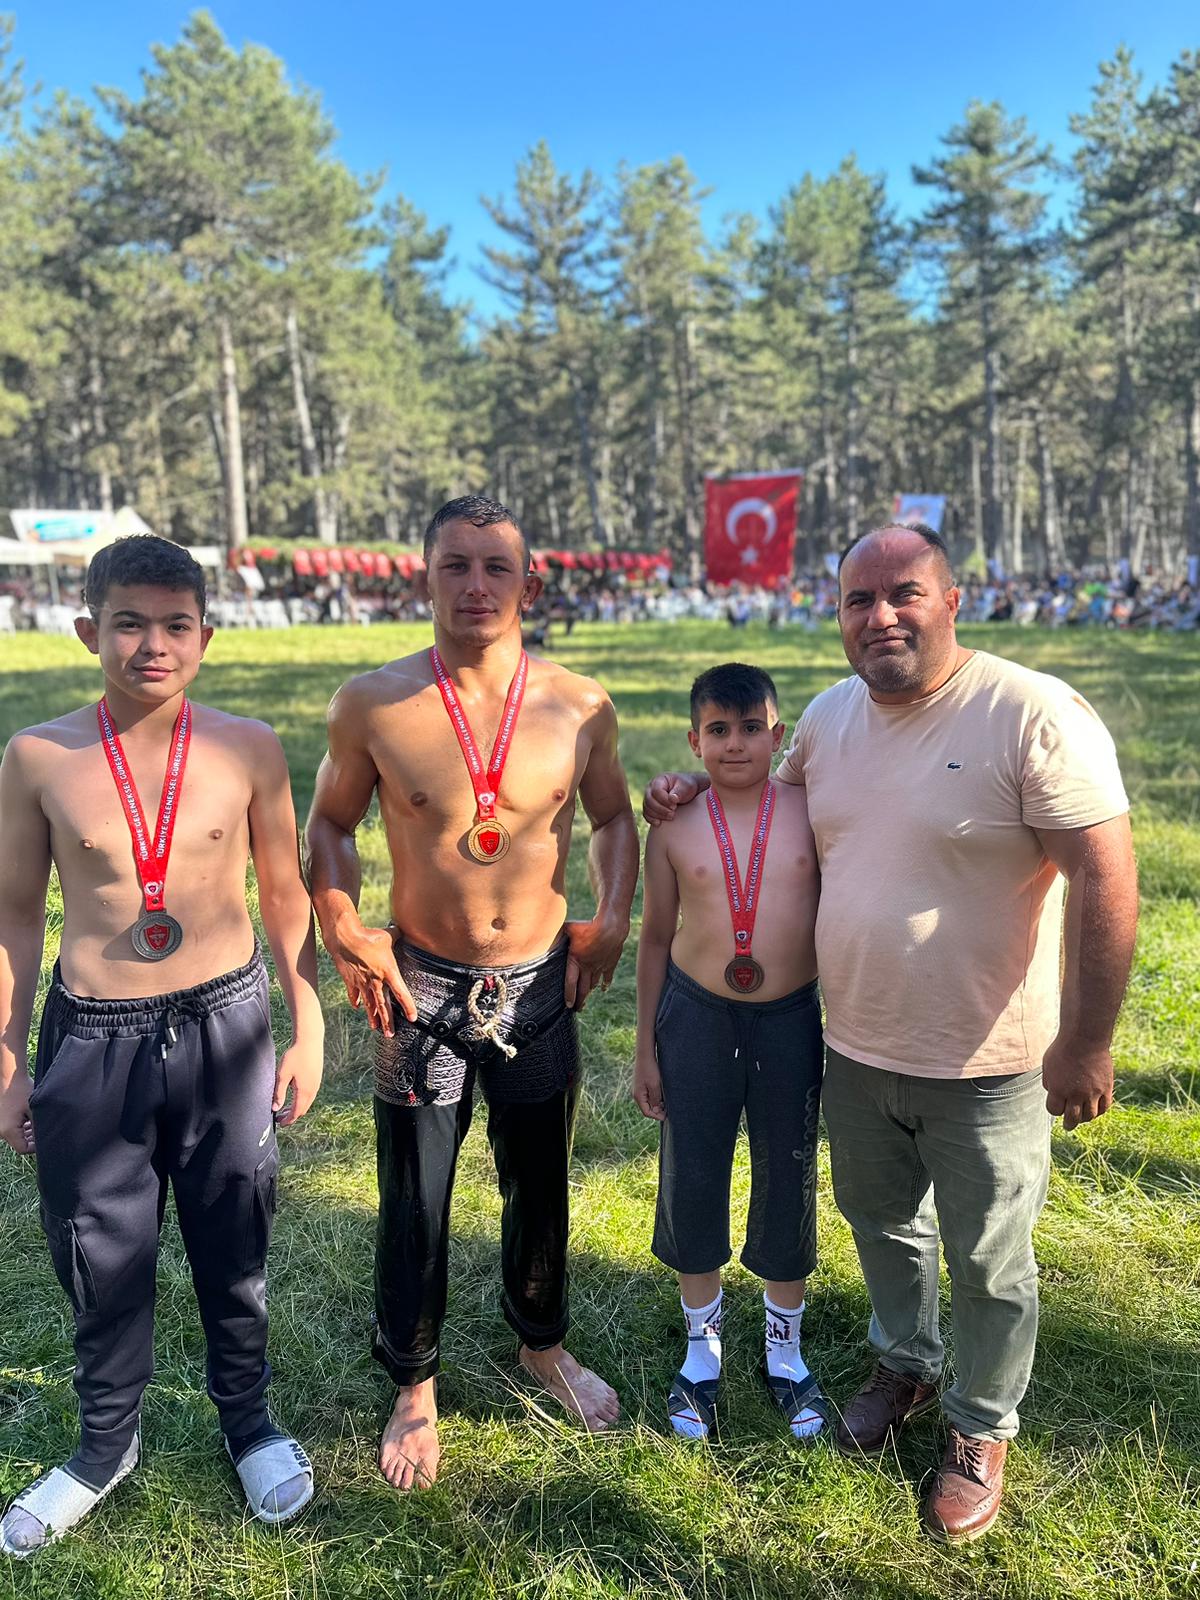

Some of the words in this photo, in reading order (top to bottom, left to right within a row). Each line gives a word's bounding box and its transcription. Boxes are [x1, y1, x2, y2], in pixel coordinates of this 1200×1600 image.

[110, 745, 127, 779] GÜREŞLER
[123, 780, 142, 827] GELENEKSEL
[156, 826, 168, 858] TÜRKİYE
[163, 778, 177, 823] GELENEKSEL
[172, 743, 185, 776] GÜREŞLER
[136, 828, 150, 861] TÜRKİYE
[289, 1443, 310, 1468] BRN
